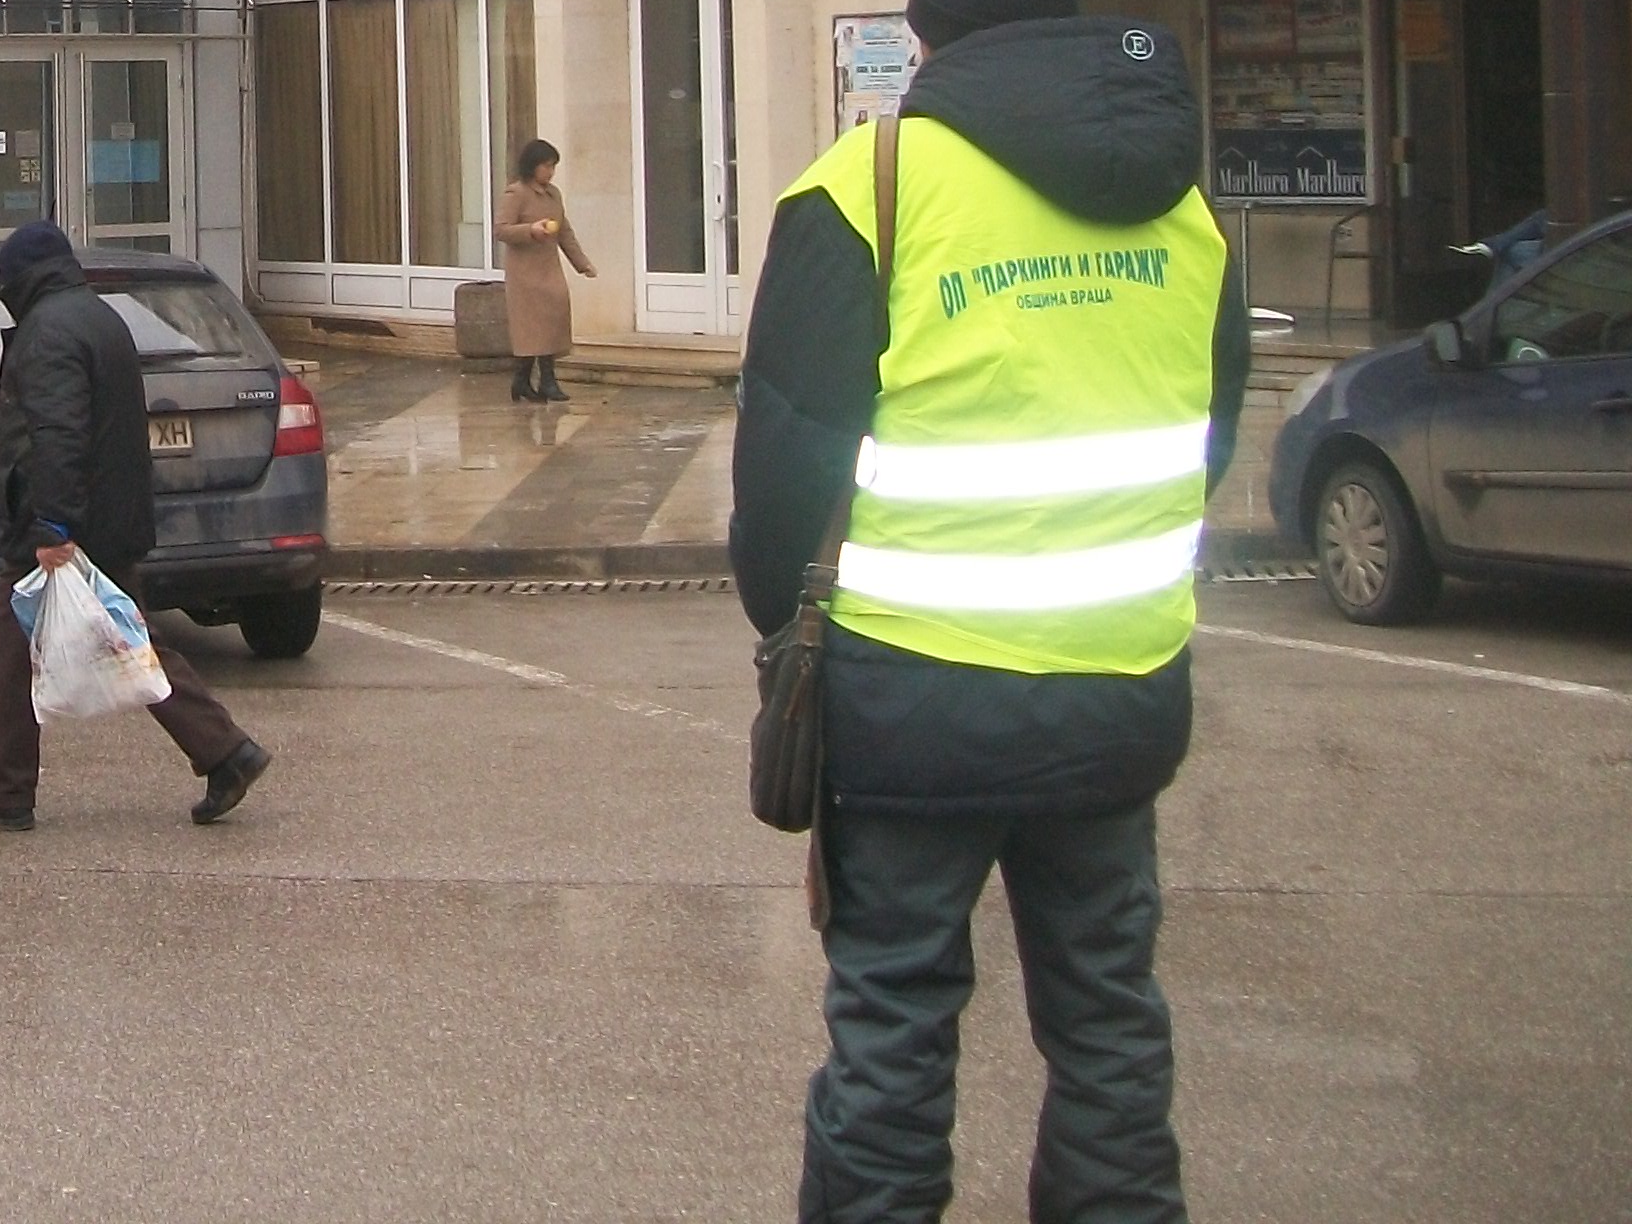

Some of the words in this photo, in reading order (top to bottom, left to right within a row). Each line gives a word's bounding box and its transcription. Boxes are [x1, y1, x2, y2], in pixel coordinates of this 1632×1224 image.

[1220, 159, 1290, 194] Marlboro
[938, 270, 967, 320] ОП
[1076, 252, 1090, 277] И
[1016, 292, 1068, 310] ОБЩИНА
[1070, 287, 1114, 306] ВРАЦА
